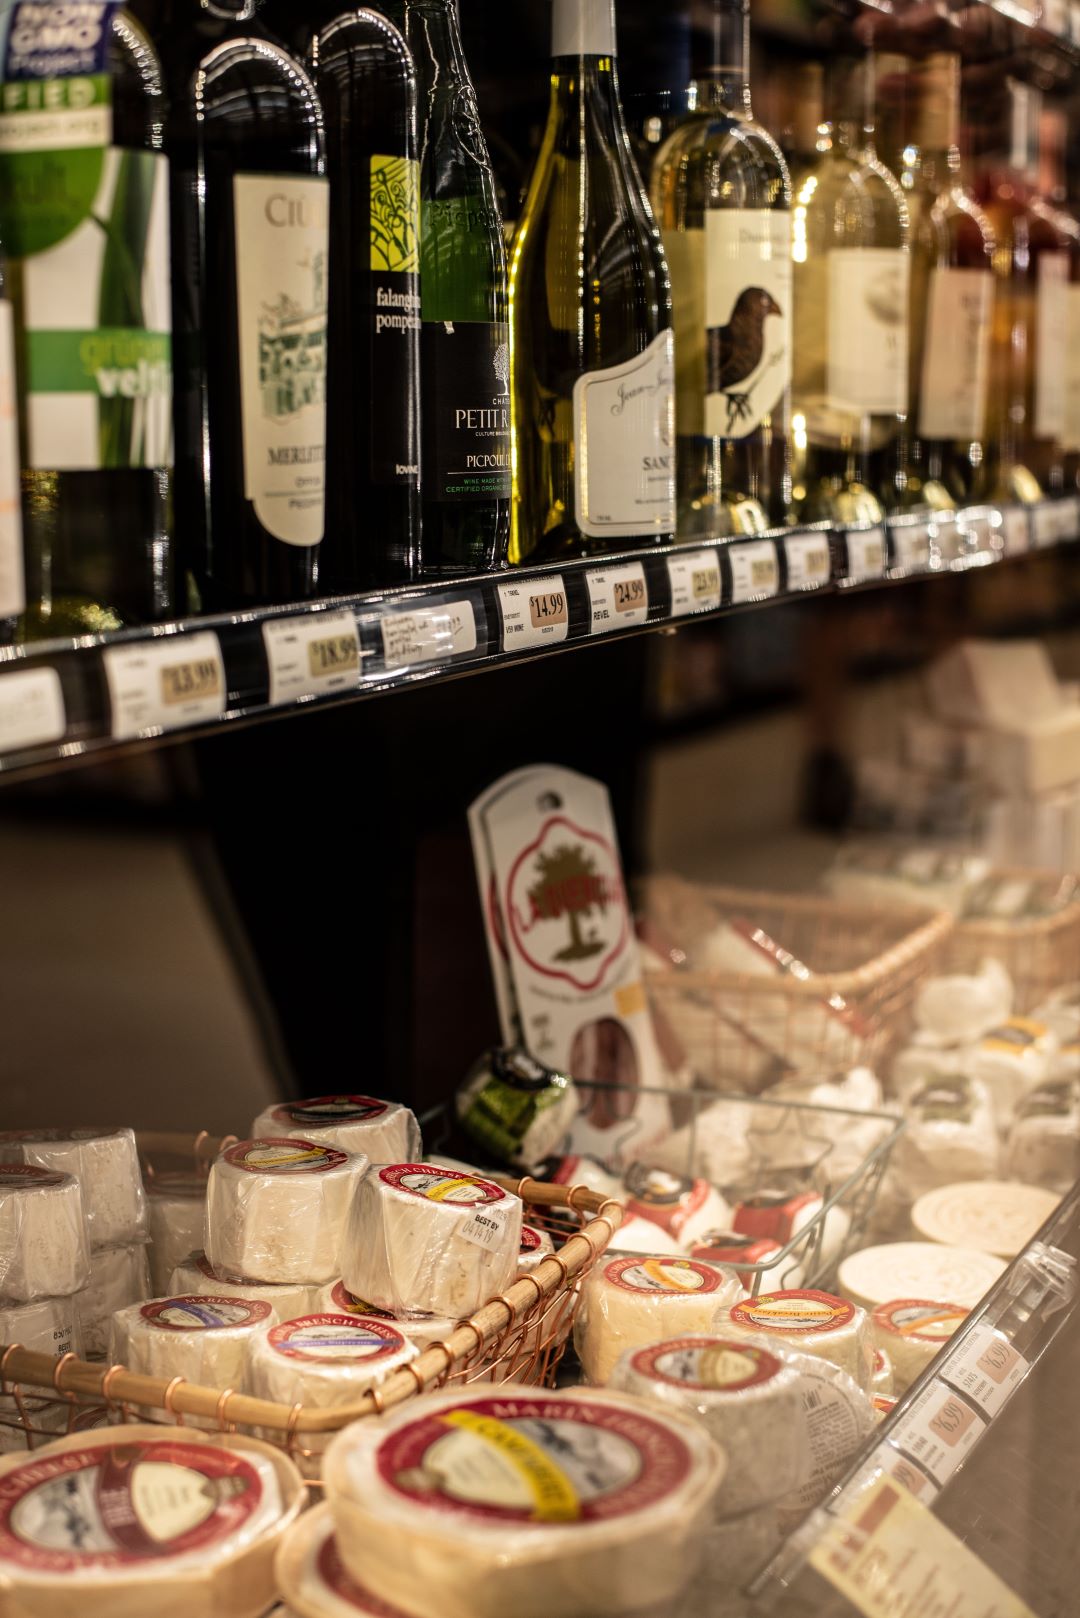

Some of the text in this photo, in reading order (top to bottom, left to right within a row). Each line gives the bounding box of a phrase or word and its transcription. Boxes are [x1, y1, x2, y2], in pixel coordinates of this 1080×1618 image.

[11, 24, 102, 55] GMO
[455, 409, 499, 429] PETIT
[615, 580, 644, 603] $24.99
[530, 594, 564, 618] $14.99
[475, 1214, 491, 1227] BEST
[490, 1221, 500, 1231] BY
[295, 1317, 353, 1329] FRENCH
[356, 1320, 397, 1339] CHEESE
[980, 1342, 1010, 1369] $6.99
[493, 1402, 595, 1423] MARIN
[933, 1402, 964, 1433] $6.99
